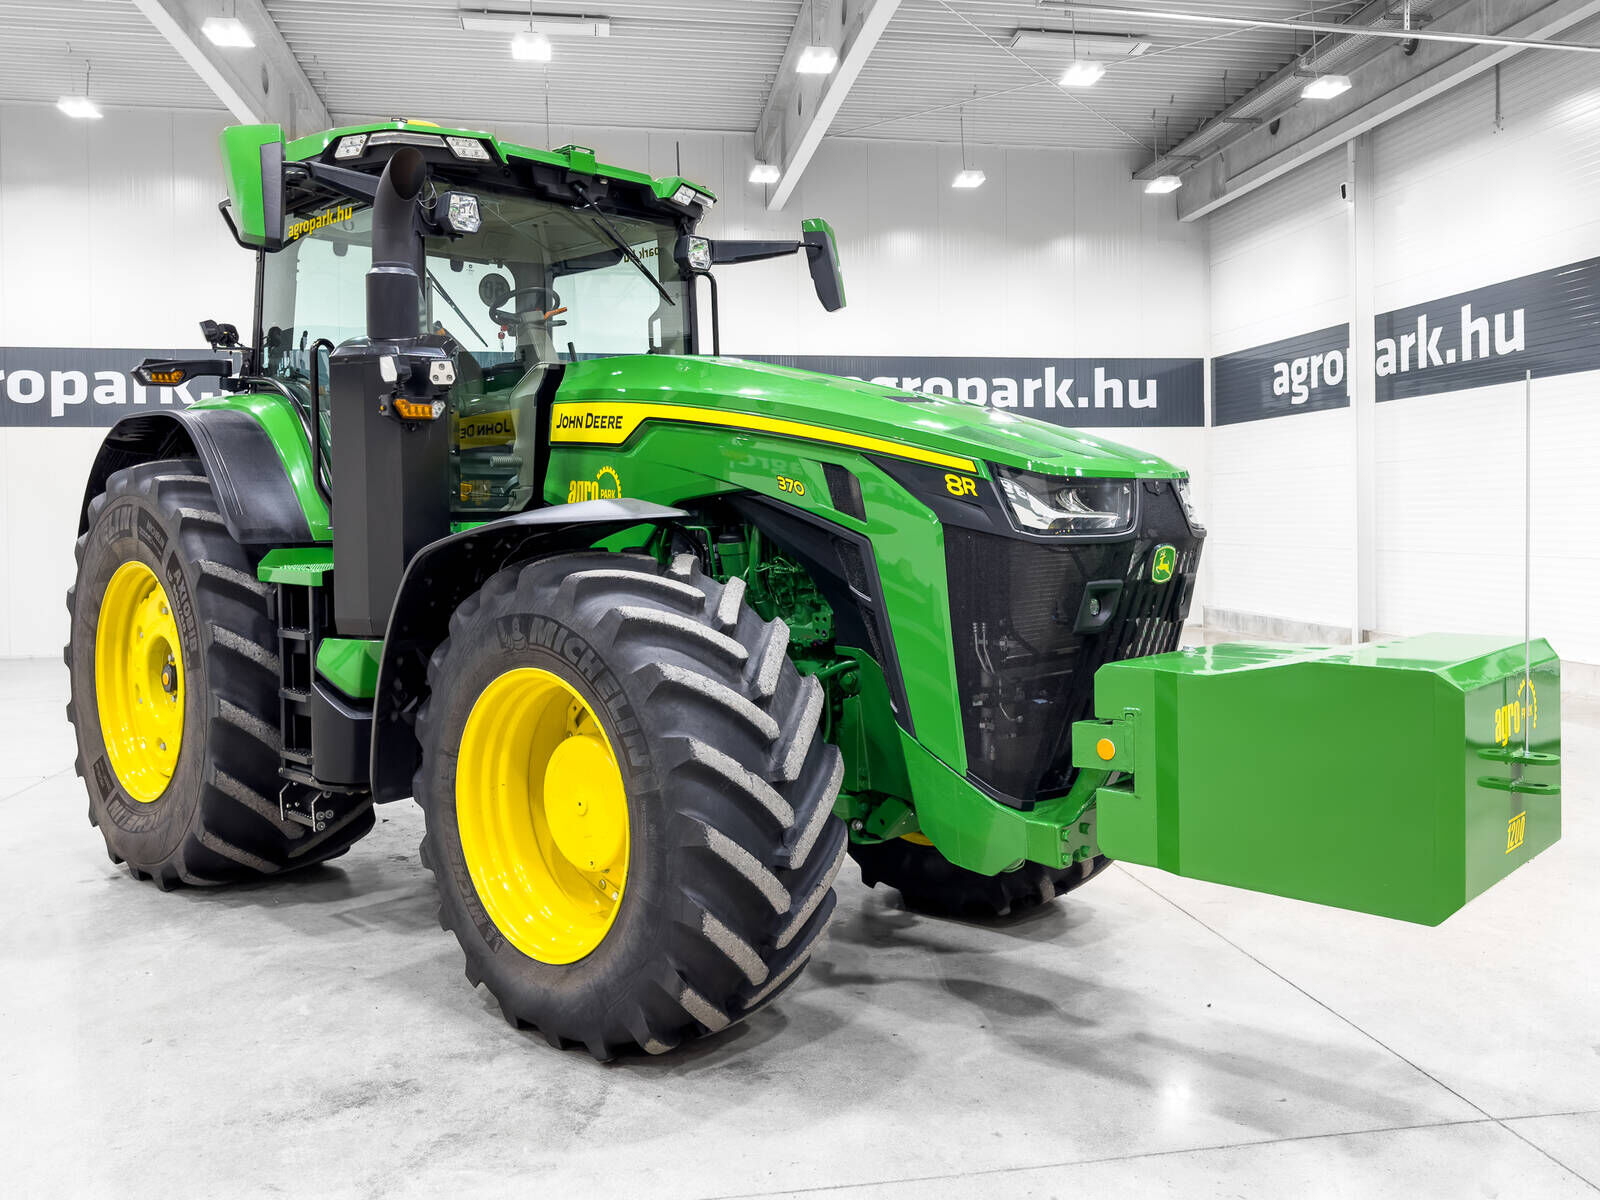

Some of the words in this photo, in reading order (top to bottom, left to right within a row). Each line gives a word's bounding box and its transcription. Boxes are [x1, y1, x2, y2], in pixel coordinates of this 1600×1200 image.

[287, 205, 353, 240] agropark.hu
[1273, 303, 1525, 405] agroark.hu
[843, 367, 1158, 408] ropark.hu
[556, 413, 583, 429] JOHN
[585, 412, 623, 429] DEERE
[777, 475, 805, 496] 370
[944, 473, 979, 497] 8R
[529, 617, 653, 768] MICHELIN
[1495, 700, 1520, 747] agro
[1507, 816, 1526, 849] 1200
